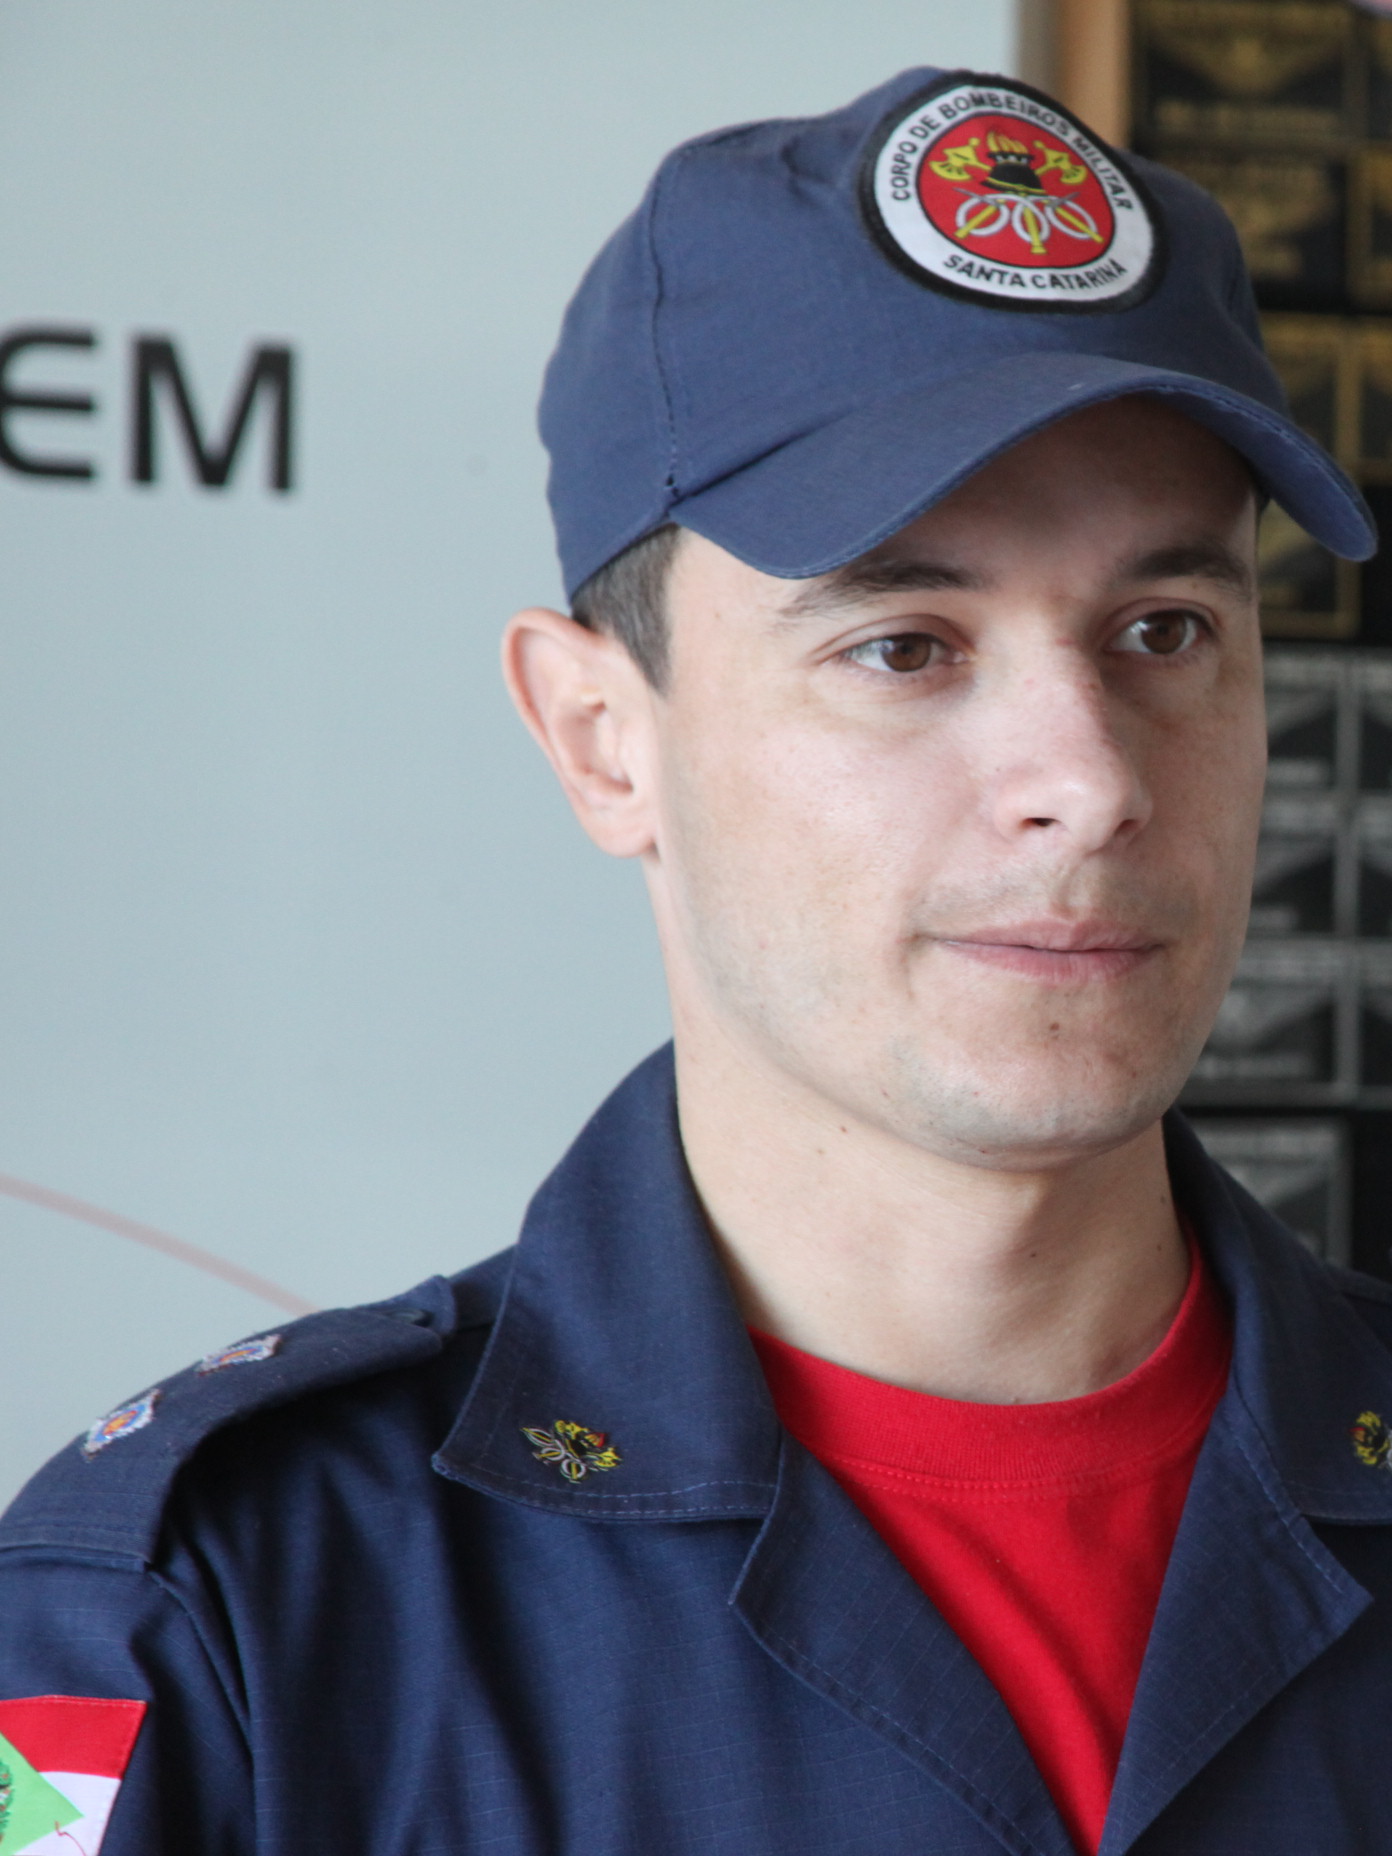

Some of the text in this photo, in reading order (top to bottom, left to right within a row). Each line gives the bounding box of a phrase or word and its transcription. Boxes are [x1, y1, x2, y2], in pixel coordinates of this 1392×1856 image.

[890, 91, 1135, 211] CORPO DE BOMBEIROS MILITAR
[943, 254, 1128, 291] SANTA CATARINA
